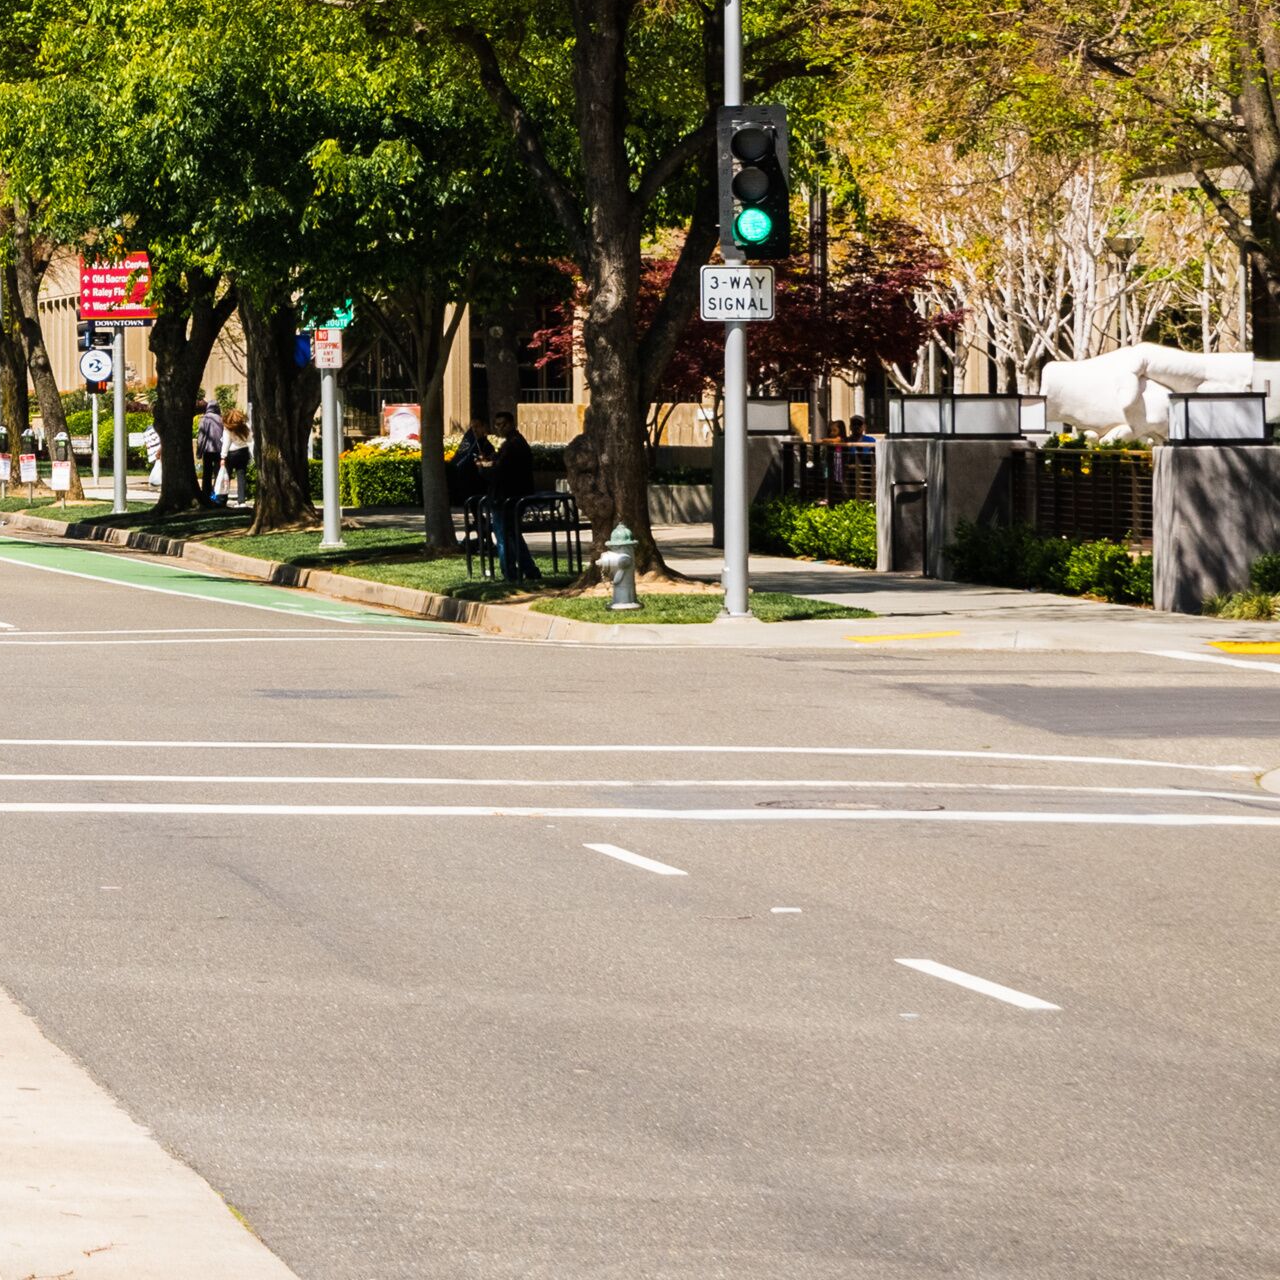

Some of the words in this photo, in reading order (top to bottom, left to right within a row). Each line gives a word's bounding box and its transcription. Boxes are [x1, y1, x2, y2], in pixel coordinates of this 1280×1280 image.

[125, 261, 149, 269] Center
[92, 274, 105, 284] Old
[105, 274, 149, 284] Sacranto
[700, 276, 766, 290] 3-WAY
[92, 288, 113, 298] Raley
[708, 297, 769, 311] SIGNAL
[318, 330, 328, 340] NO
